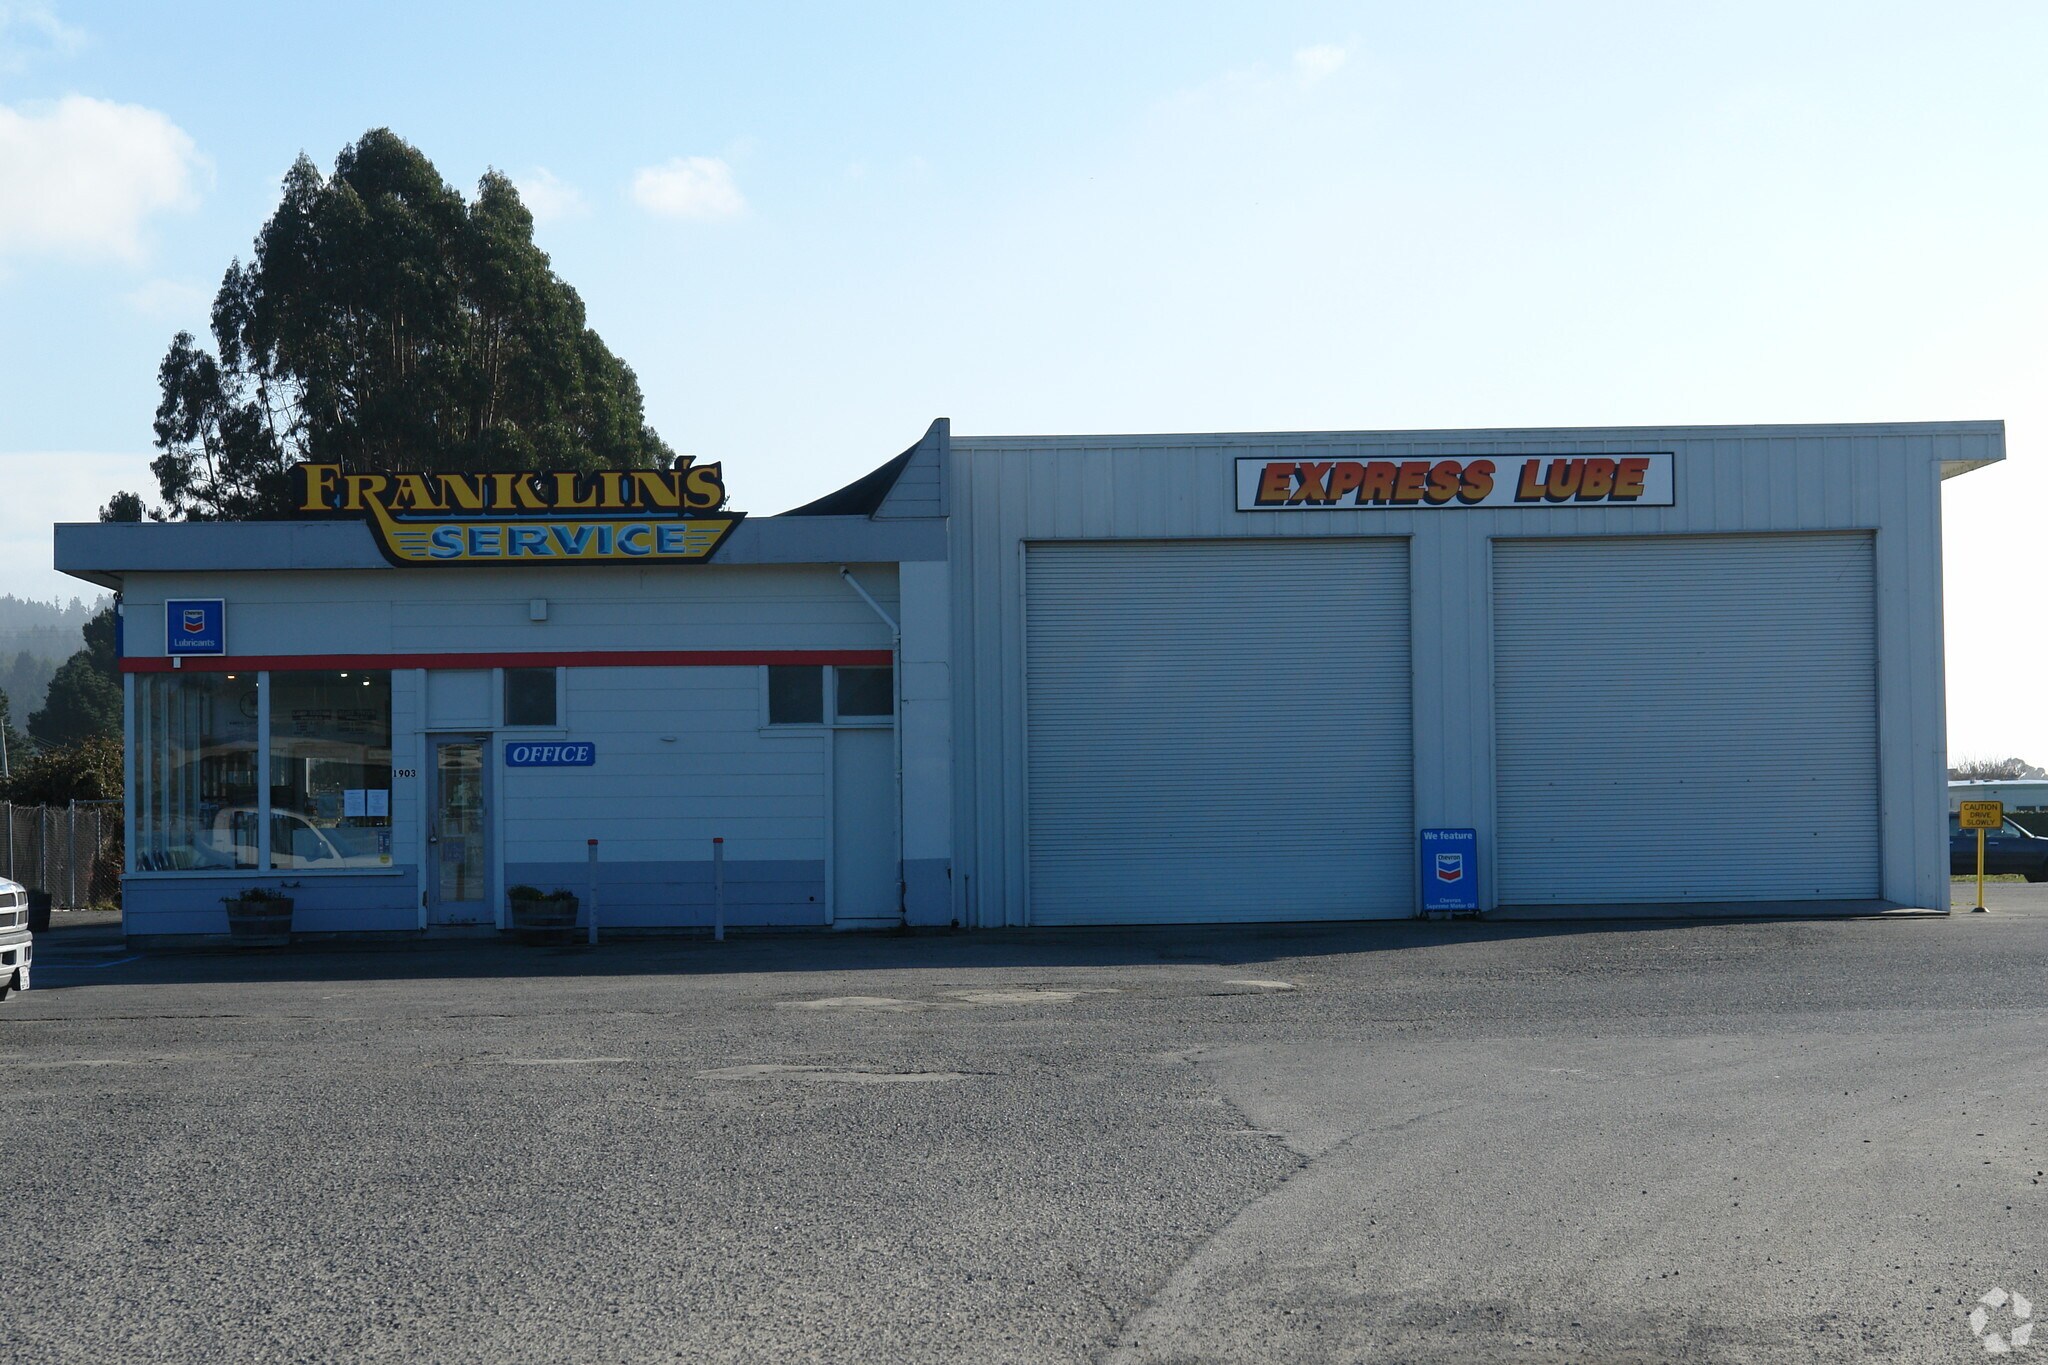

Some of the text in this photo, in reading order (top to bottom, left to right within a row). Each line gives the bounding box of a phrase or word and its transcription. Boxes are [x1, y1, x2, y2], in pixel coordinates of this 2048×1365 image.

[298, 458, 722, 510] FRANKLIN'S
[1256, 457, 1650, 504] EXPRESS LUBE
[428, 523, 687, 560] SERVICE
[174, 638, 215, 647] Lubricants
[513, 746, 589, 763] OFFICE
[393, 769, 416, 778] 1903
[1424, 831, 1473, 840] We feature
